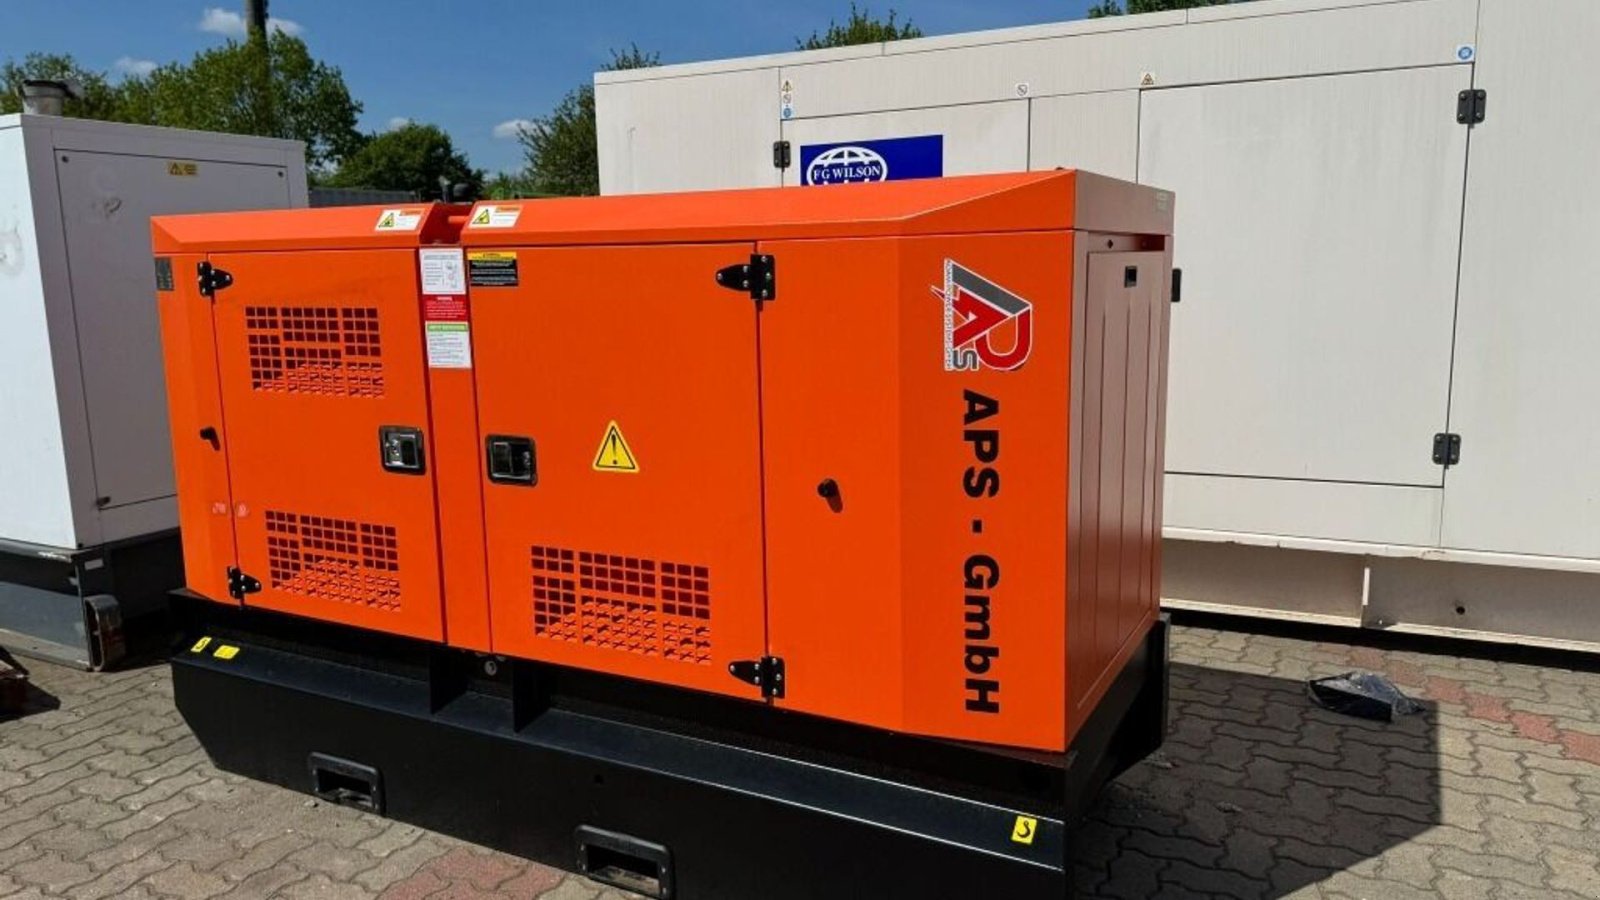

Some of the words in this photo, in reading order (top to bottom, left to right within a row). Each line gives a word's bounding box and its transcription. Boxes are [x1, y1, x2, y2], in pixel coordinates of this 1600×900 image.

[813, 168, 831, 181] FG
[832, 165, 881, 179] WILSON
[963, 388, 1000, 498] APS
[963, 554, 1000, 714] GmbH
